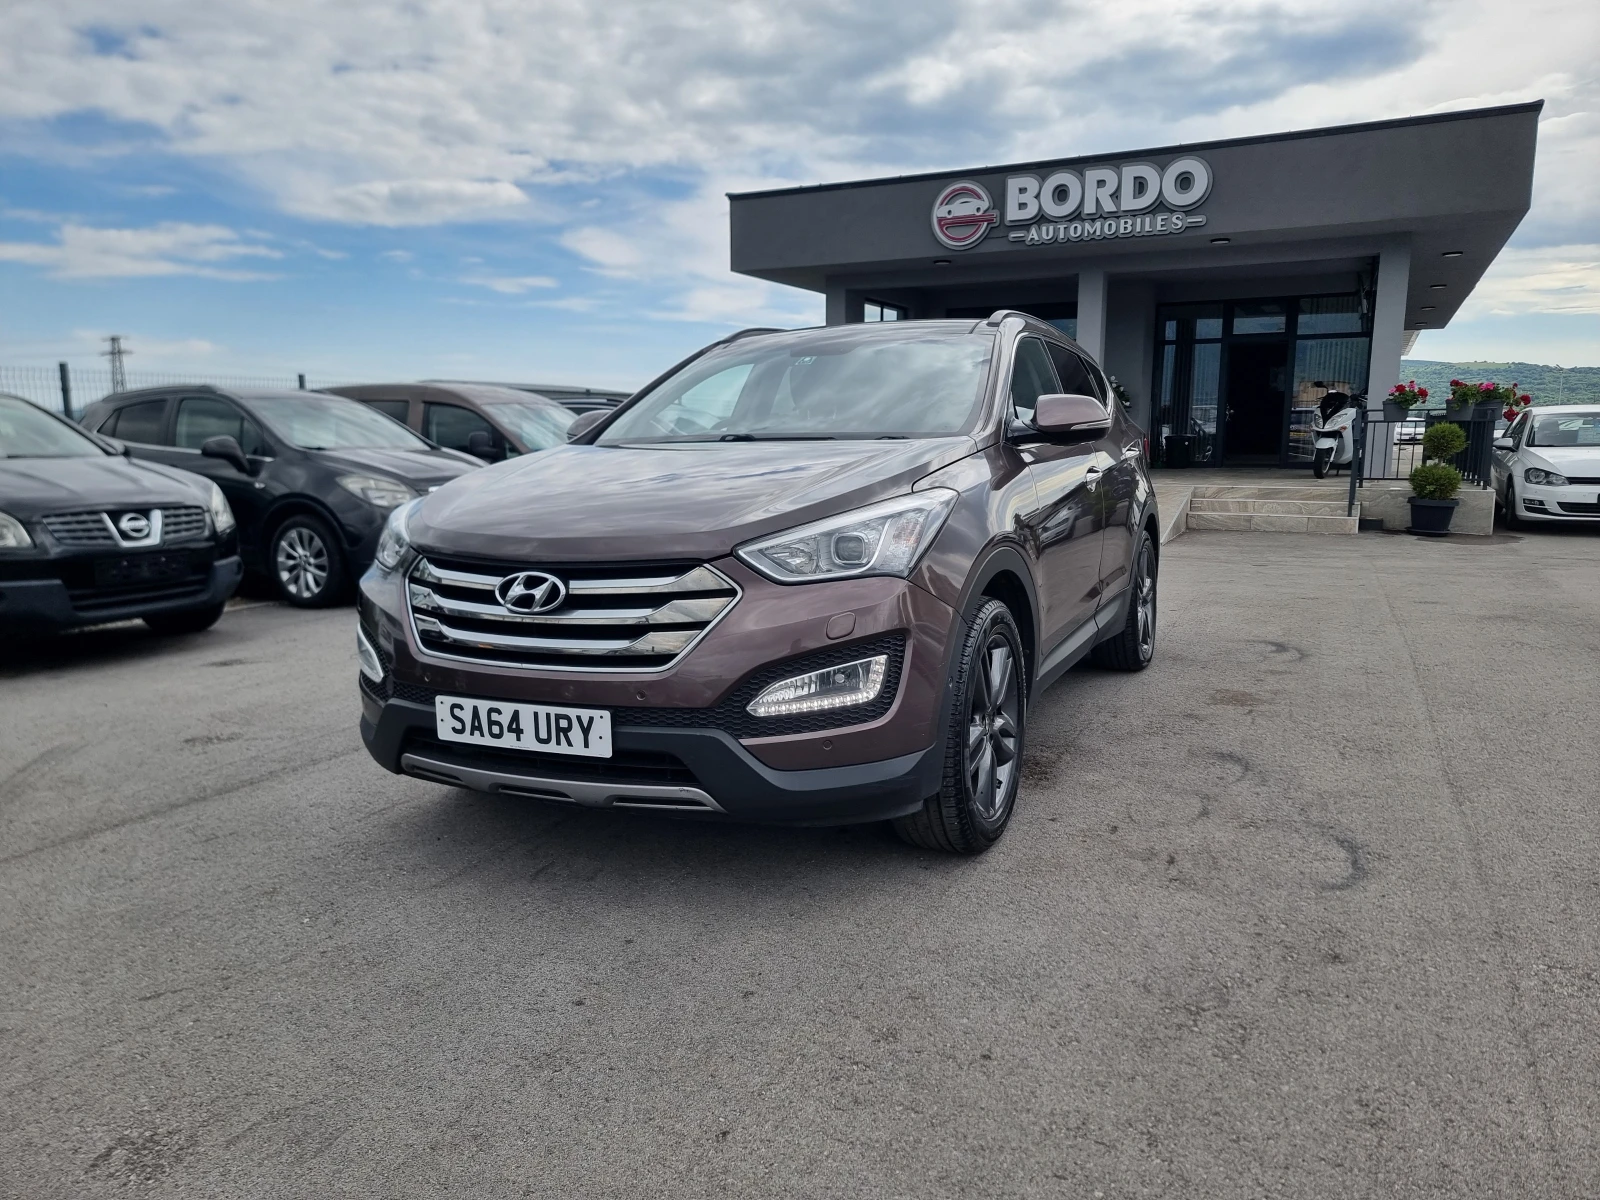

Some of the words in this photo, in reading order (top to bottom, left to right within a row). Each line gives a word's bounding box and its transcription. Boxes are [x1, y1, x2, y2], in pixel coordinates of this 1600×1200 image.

[1005, 158, 1210, 222] BORDO
[1027, 213, 1184, 242] AUTOMOBILES
[449, 702, 525, 742] SA64
[533, 711, 596, 749] URY
